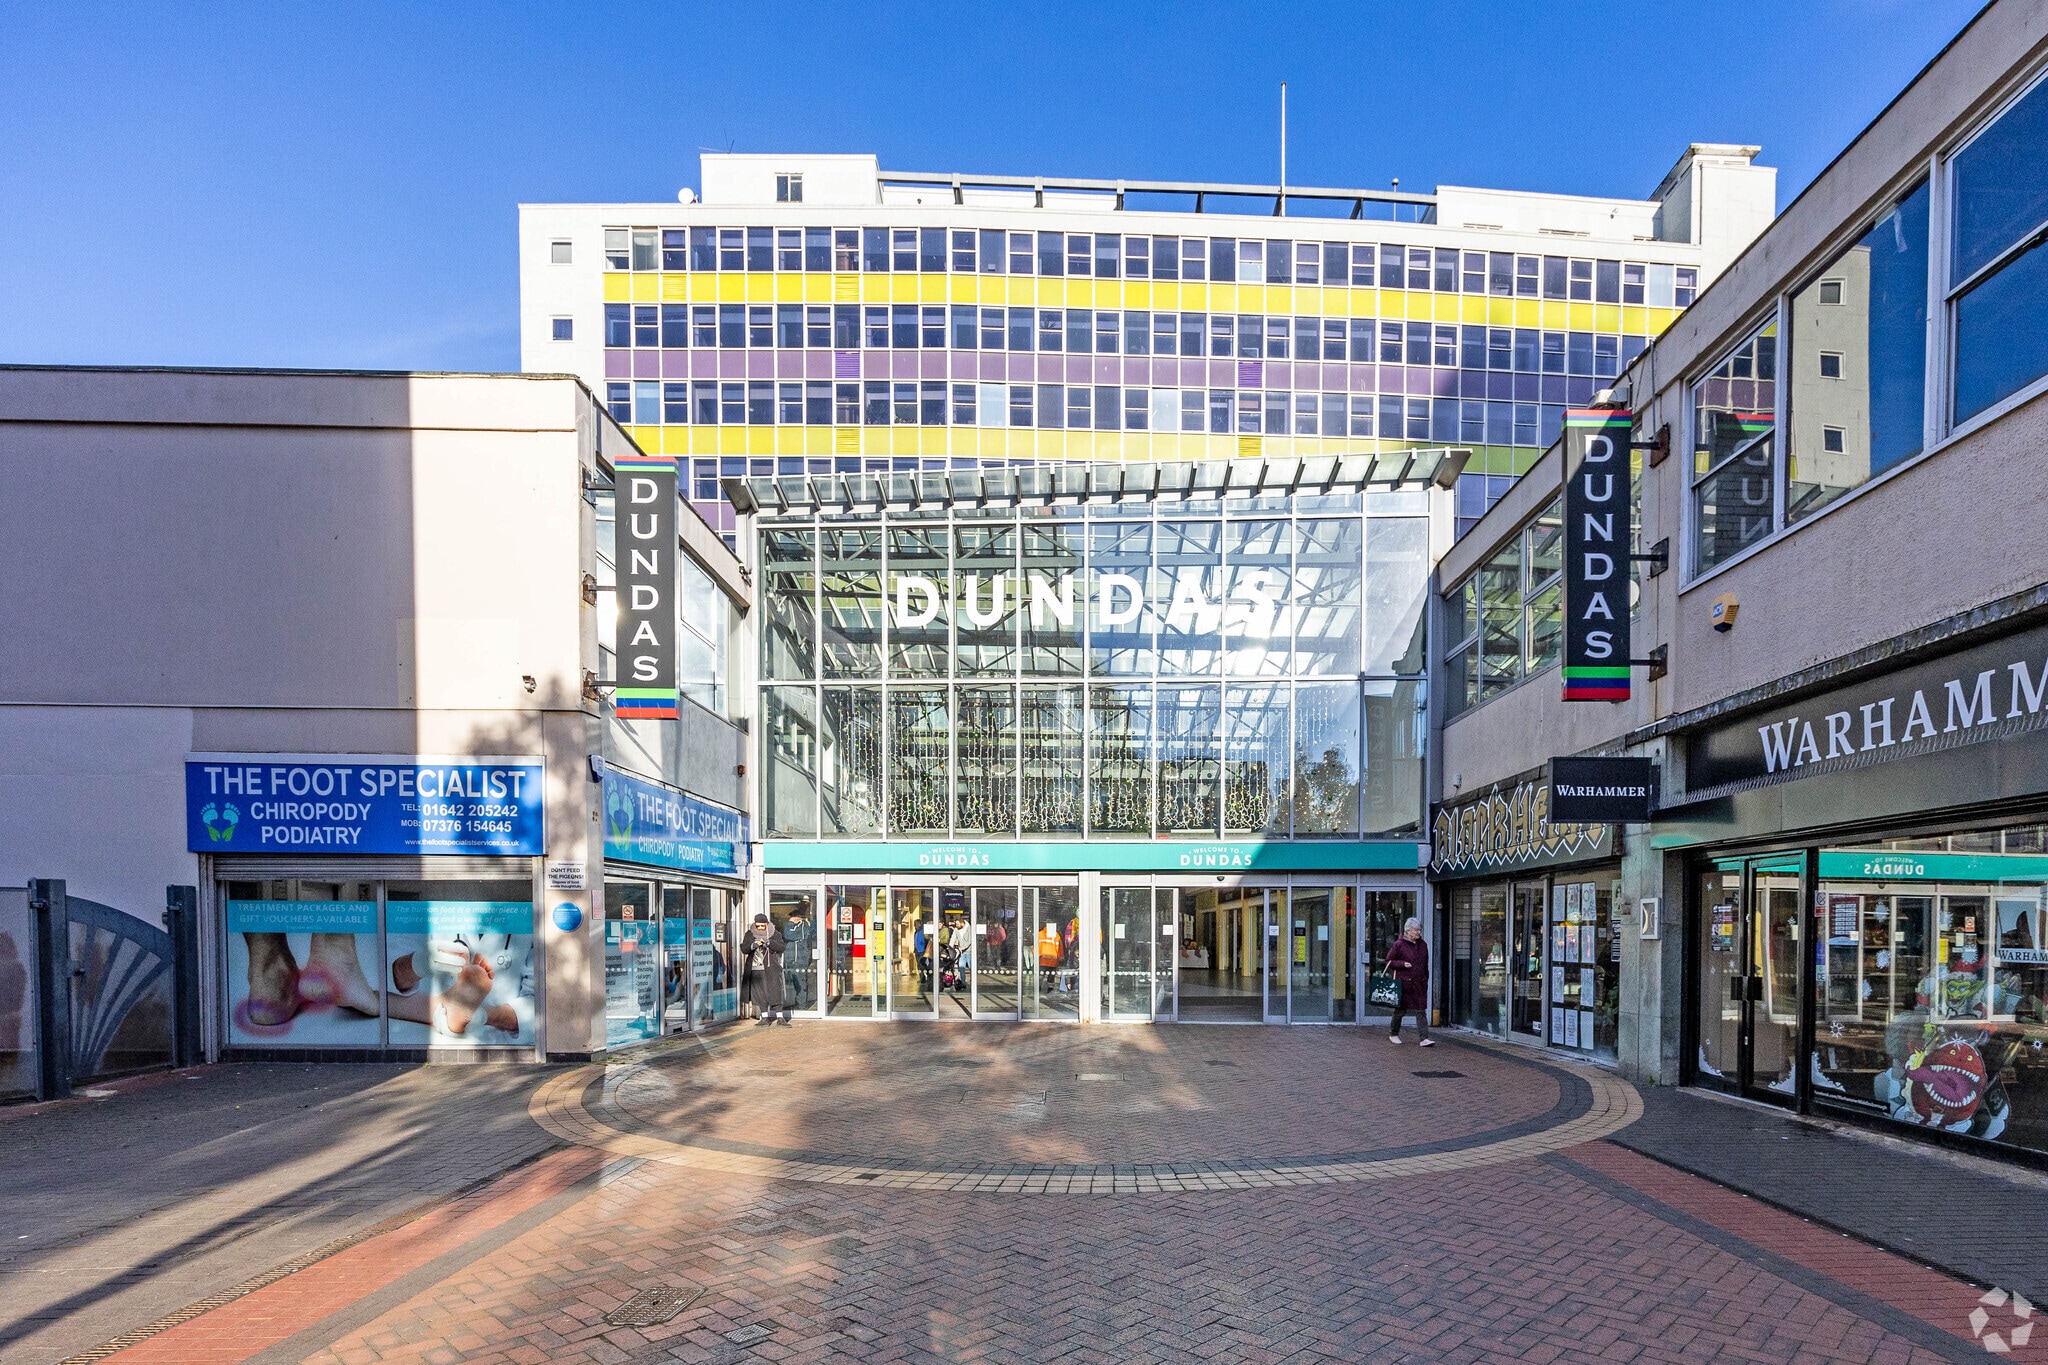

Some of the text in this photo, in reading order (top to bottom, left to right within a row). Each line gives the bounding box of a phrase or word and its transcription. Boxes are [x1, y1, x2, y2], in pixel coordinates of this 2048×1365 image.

[1582, 434, 1614, 659] DUNDAS
[630, 478, 660, 681] DUNDAS
[896, 571, 1277, 629] DUNDAS
[1758, 660, 2048, 773] WARHAMM
[204, 767, 526, 798] THE FOOT SPECIALIST
[1556, 785, 1646, 796] WARHAMMER
[251, 802, 371, 820] CHIROPODY
[422, 804, 464, 816] 01642
[468, 804, 518, 817] 205242
[637, 792, 663, 826] THE
[666, 801, 697, 834] FOOT
[261, 826, 362, 844] PODIATRY
[423, 820, 461, 832] 07376
[466, 821, 512, 832] 154645
[638, 836, 675, 858] CHIROPODY
[678, 844, 704, 863] PODIATRY
[919, 854, 990, 866] DUNDAS
[1180, 854, 1252, 866] DUNDAS
[238, 903, 369, 912] TREATMENT PACKAGES AND
[240, 914, 368, 923] GIFT VOUCHERS AVAILABLE
